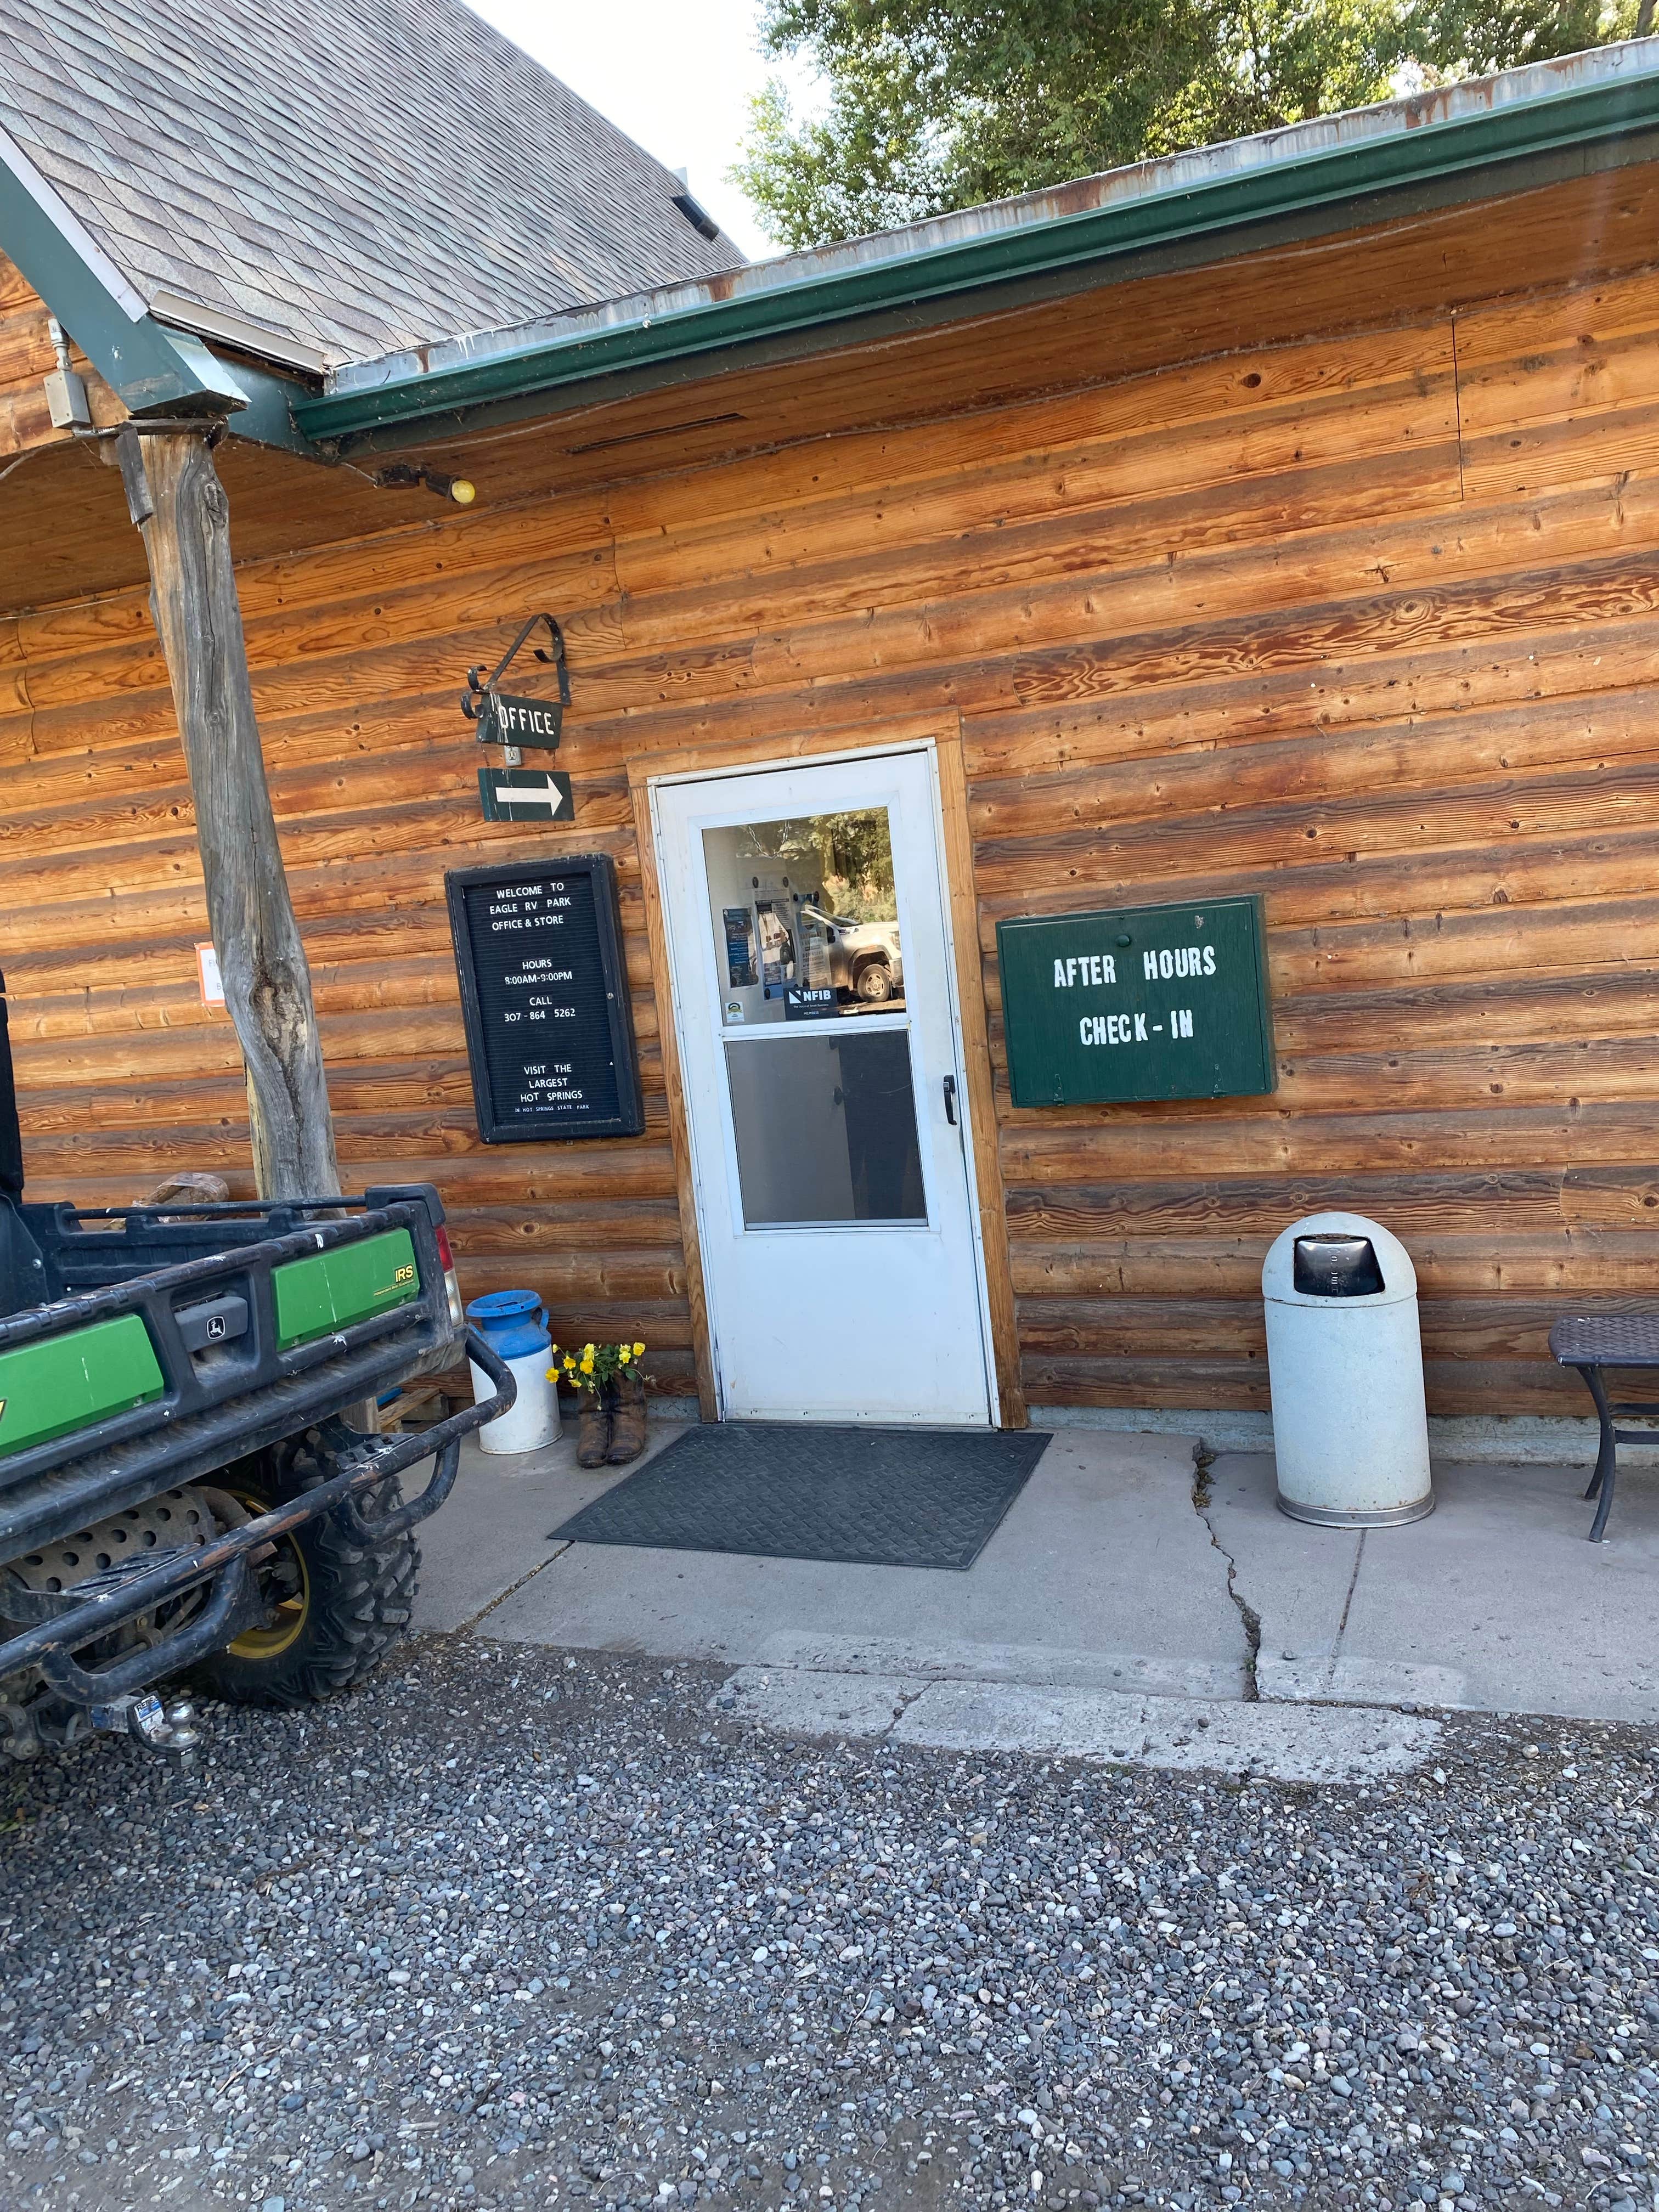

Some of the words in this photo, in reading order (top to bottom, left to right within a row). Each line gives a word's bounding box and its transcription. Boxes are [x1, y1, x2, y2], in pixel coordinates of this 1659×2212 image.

[498, 705, 554, 735] OFFICE
[496, 885, 543, 899] WELCOME
[550, 882, 565, 891] TO
[489, 903, 518, 915] EAGLE
[524, 901, 537, 911] RV
[546, 896, 571, 908] PARK
[492, 919, 523, 931] OFFICE
[525, 918, 532, 928] &
[534, 915, 564, 927] STORE
[522, 959, 552, 970] HOURS
[1054, 955, 1116, 988] AFTER
[1143, 945, 1216, 980] HOURS
[504, 970, 572, 985] 8:00AM-9:00PM
[529, 996, 552, 1006] CALL
[803, 988, 831, 1001] NFIB
[504, 1012, 521, 1022] 307
[529, 1010, 545, 1020] 864
[554, 1008, 576, 1018] 5262
[523, 1065, 546, 1075] VISIT
[554, 1064, 572, 1073] THE
[528, 1077, 568, 1088] LARGEST
[520, 1092, 539, 1103] HOT
[546, 1090, 583, 1101] SPRINGS
[395, 1265, 413, 1283] IRS
